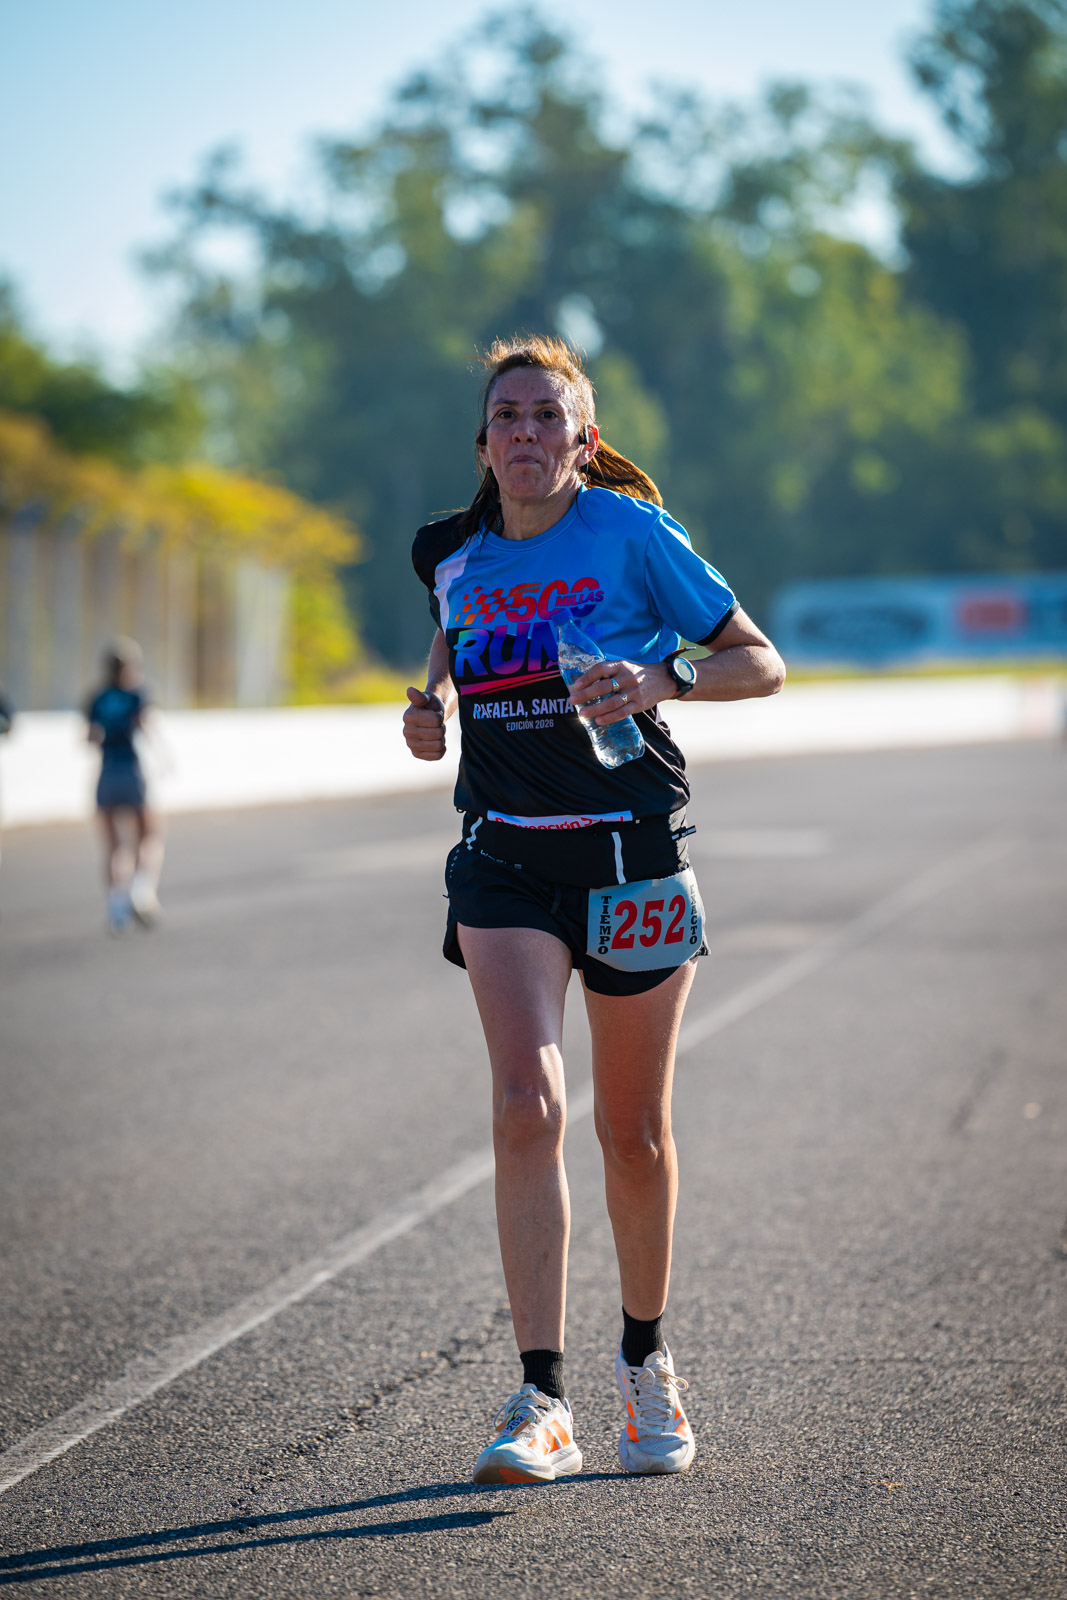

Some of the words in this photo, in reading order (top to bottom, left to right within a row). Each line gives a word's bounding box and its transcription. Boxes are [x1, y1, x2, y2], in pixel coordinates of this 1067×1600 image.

[506, 577, 600, 623] 500
[555, 590, 605, 607] MILLAS
[473, 700, 528, 719] RAFAELA,
[531, 698, 575, 715] SANTA
[506, 719, 534, 732] EDICIÓN
[535, 719, 555, 730] 2026
[598, 895, 612, 954] TIEMPO
[611, 894, 686, 950] 252
